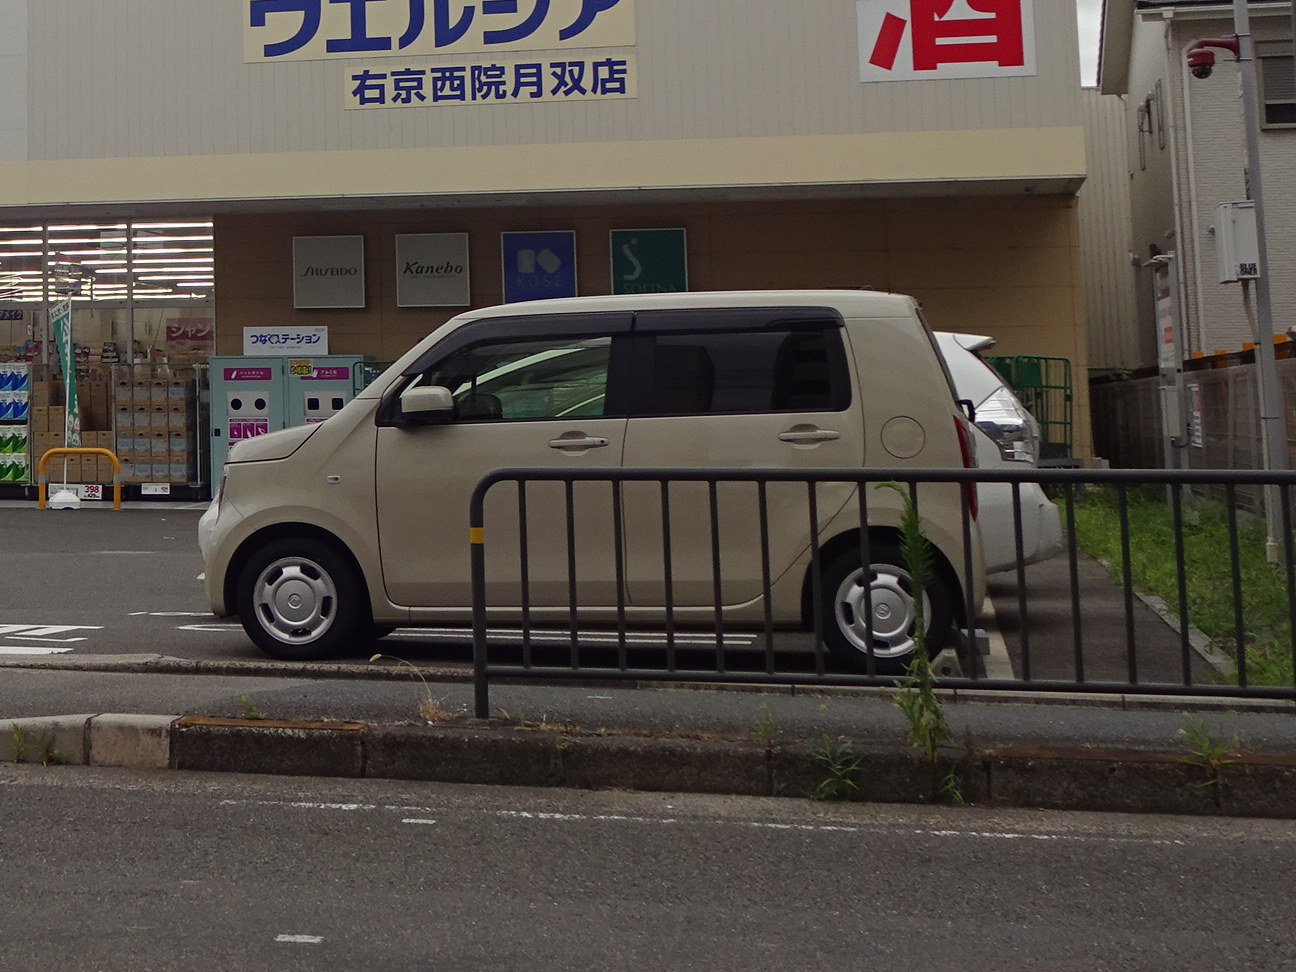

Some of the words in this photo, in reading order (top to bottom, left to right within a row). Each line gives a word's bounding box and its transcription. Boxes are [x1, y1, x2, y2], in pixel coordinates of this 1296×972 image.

[351, 58, 628, 105] 右京西院月双店
[301, 267, 357, 277] SHISEIDO
[403, 262, 463, 275] Kanebo
[84, 485, 99, 493] 398
